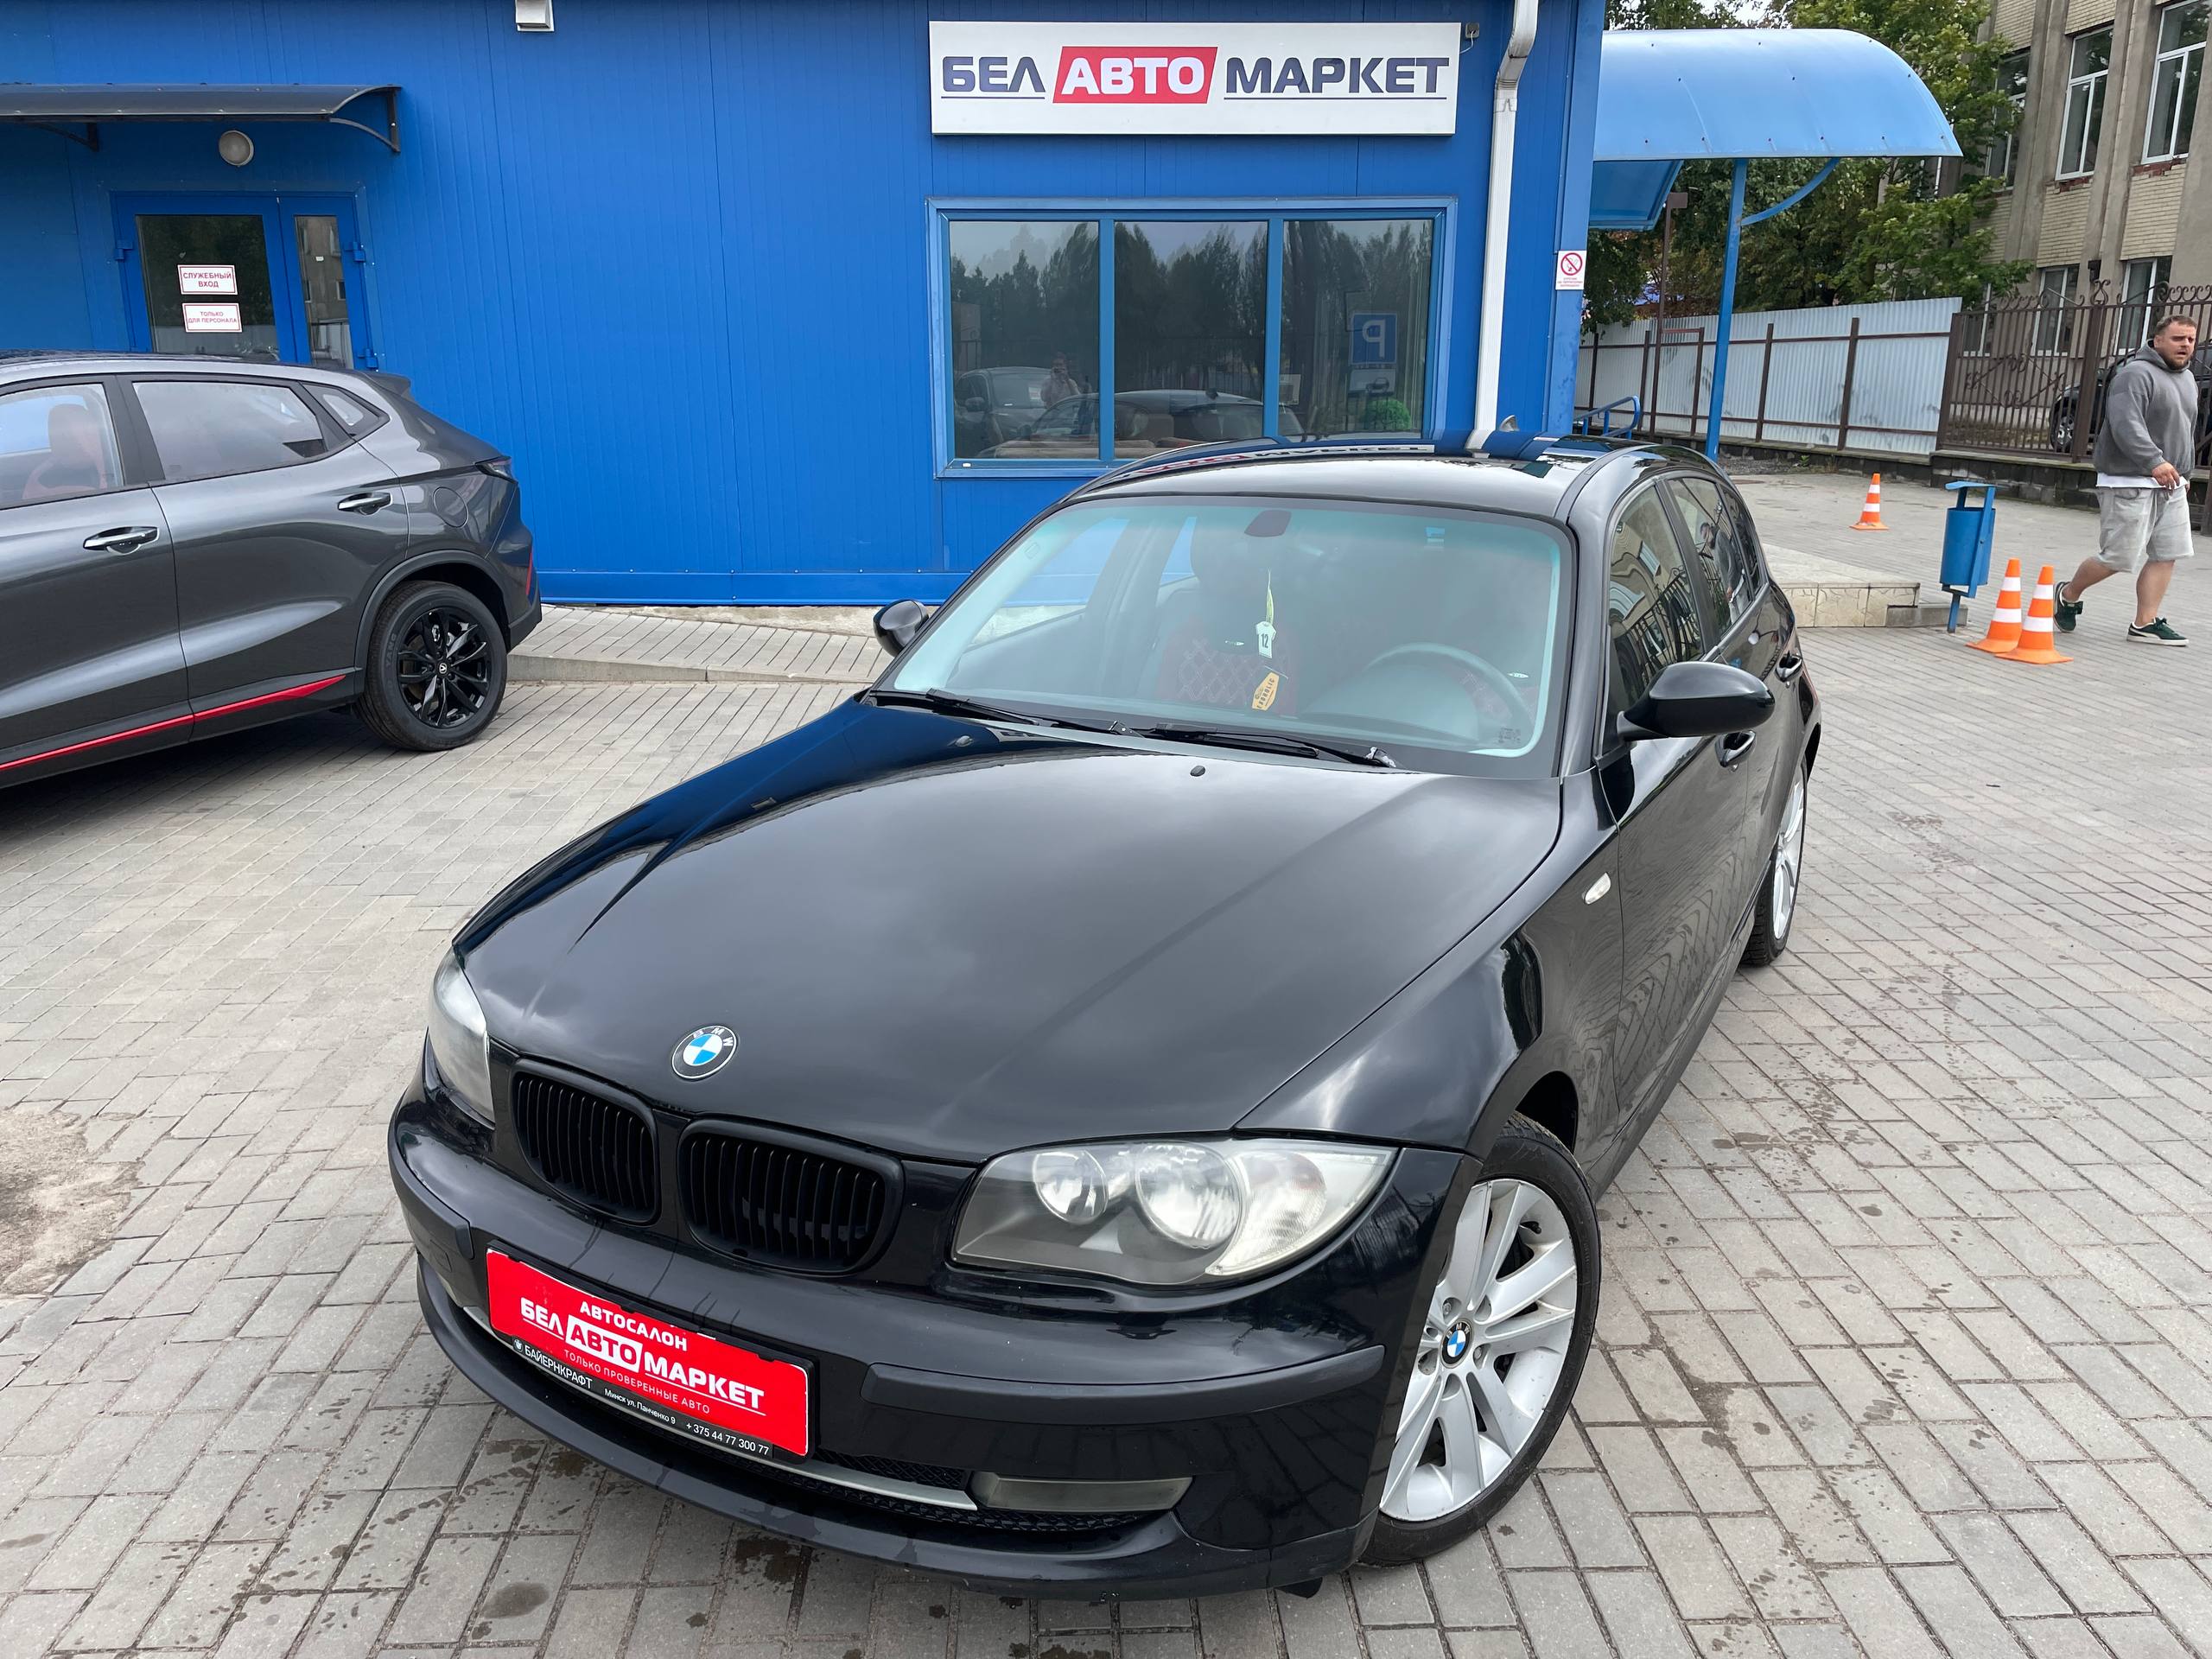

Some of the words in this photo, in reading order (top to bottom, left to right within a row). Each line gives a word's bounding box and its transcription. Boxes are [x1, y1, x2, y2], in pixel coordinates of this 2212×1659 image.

[943, 56, 1046, 92] БЕЛ
[1060, 57, 1205, 94] АВТО
[1225, 57, 1450, 93] МАРКЕТ
[1261, 633, 1269, 649] 12
[693, 1027, 734, 1046] BMW
[580, 1300, 688, 1351] АВТОСАЛОН
[1446, 1322, 1470, 1339] BMW
[520, 1297, 564, 1336] БЕЛ
[570, 1324, 638, 1365] АВТО
[644, 1351, 765, 1409] МАРКЕТ
[524, 1344, 593, 1389] БАЙЕРНКРАФТ
[563, 1349, 601, 1373] ТОЛЬКО
[604, 1367, 678, 1403] ПРОВЕРЕННЫЕ
[681, 1397, 710, 1414] АВТО
[604, 1388, 626, 1402] Минск
[637, 1401, 670, 1422] Панченко
[671, 1415, 677, 1424] 9
[693, 1424, 709, 1438] 375
[711, 1431, 722, 1442] 44
[725, 1434, 737, 1446] 77
[738, 1439, 756, 1452] 300
[758, 1444, 769, 1456] 77
